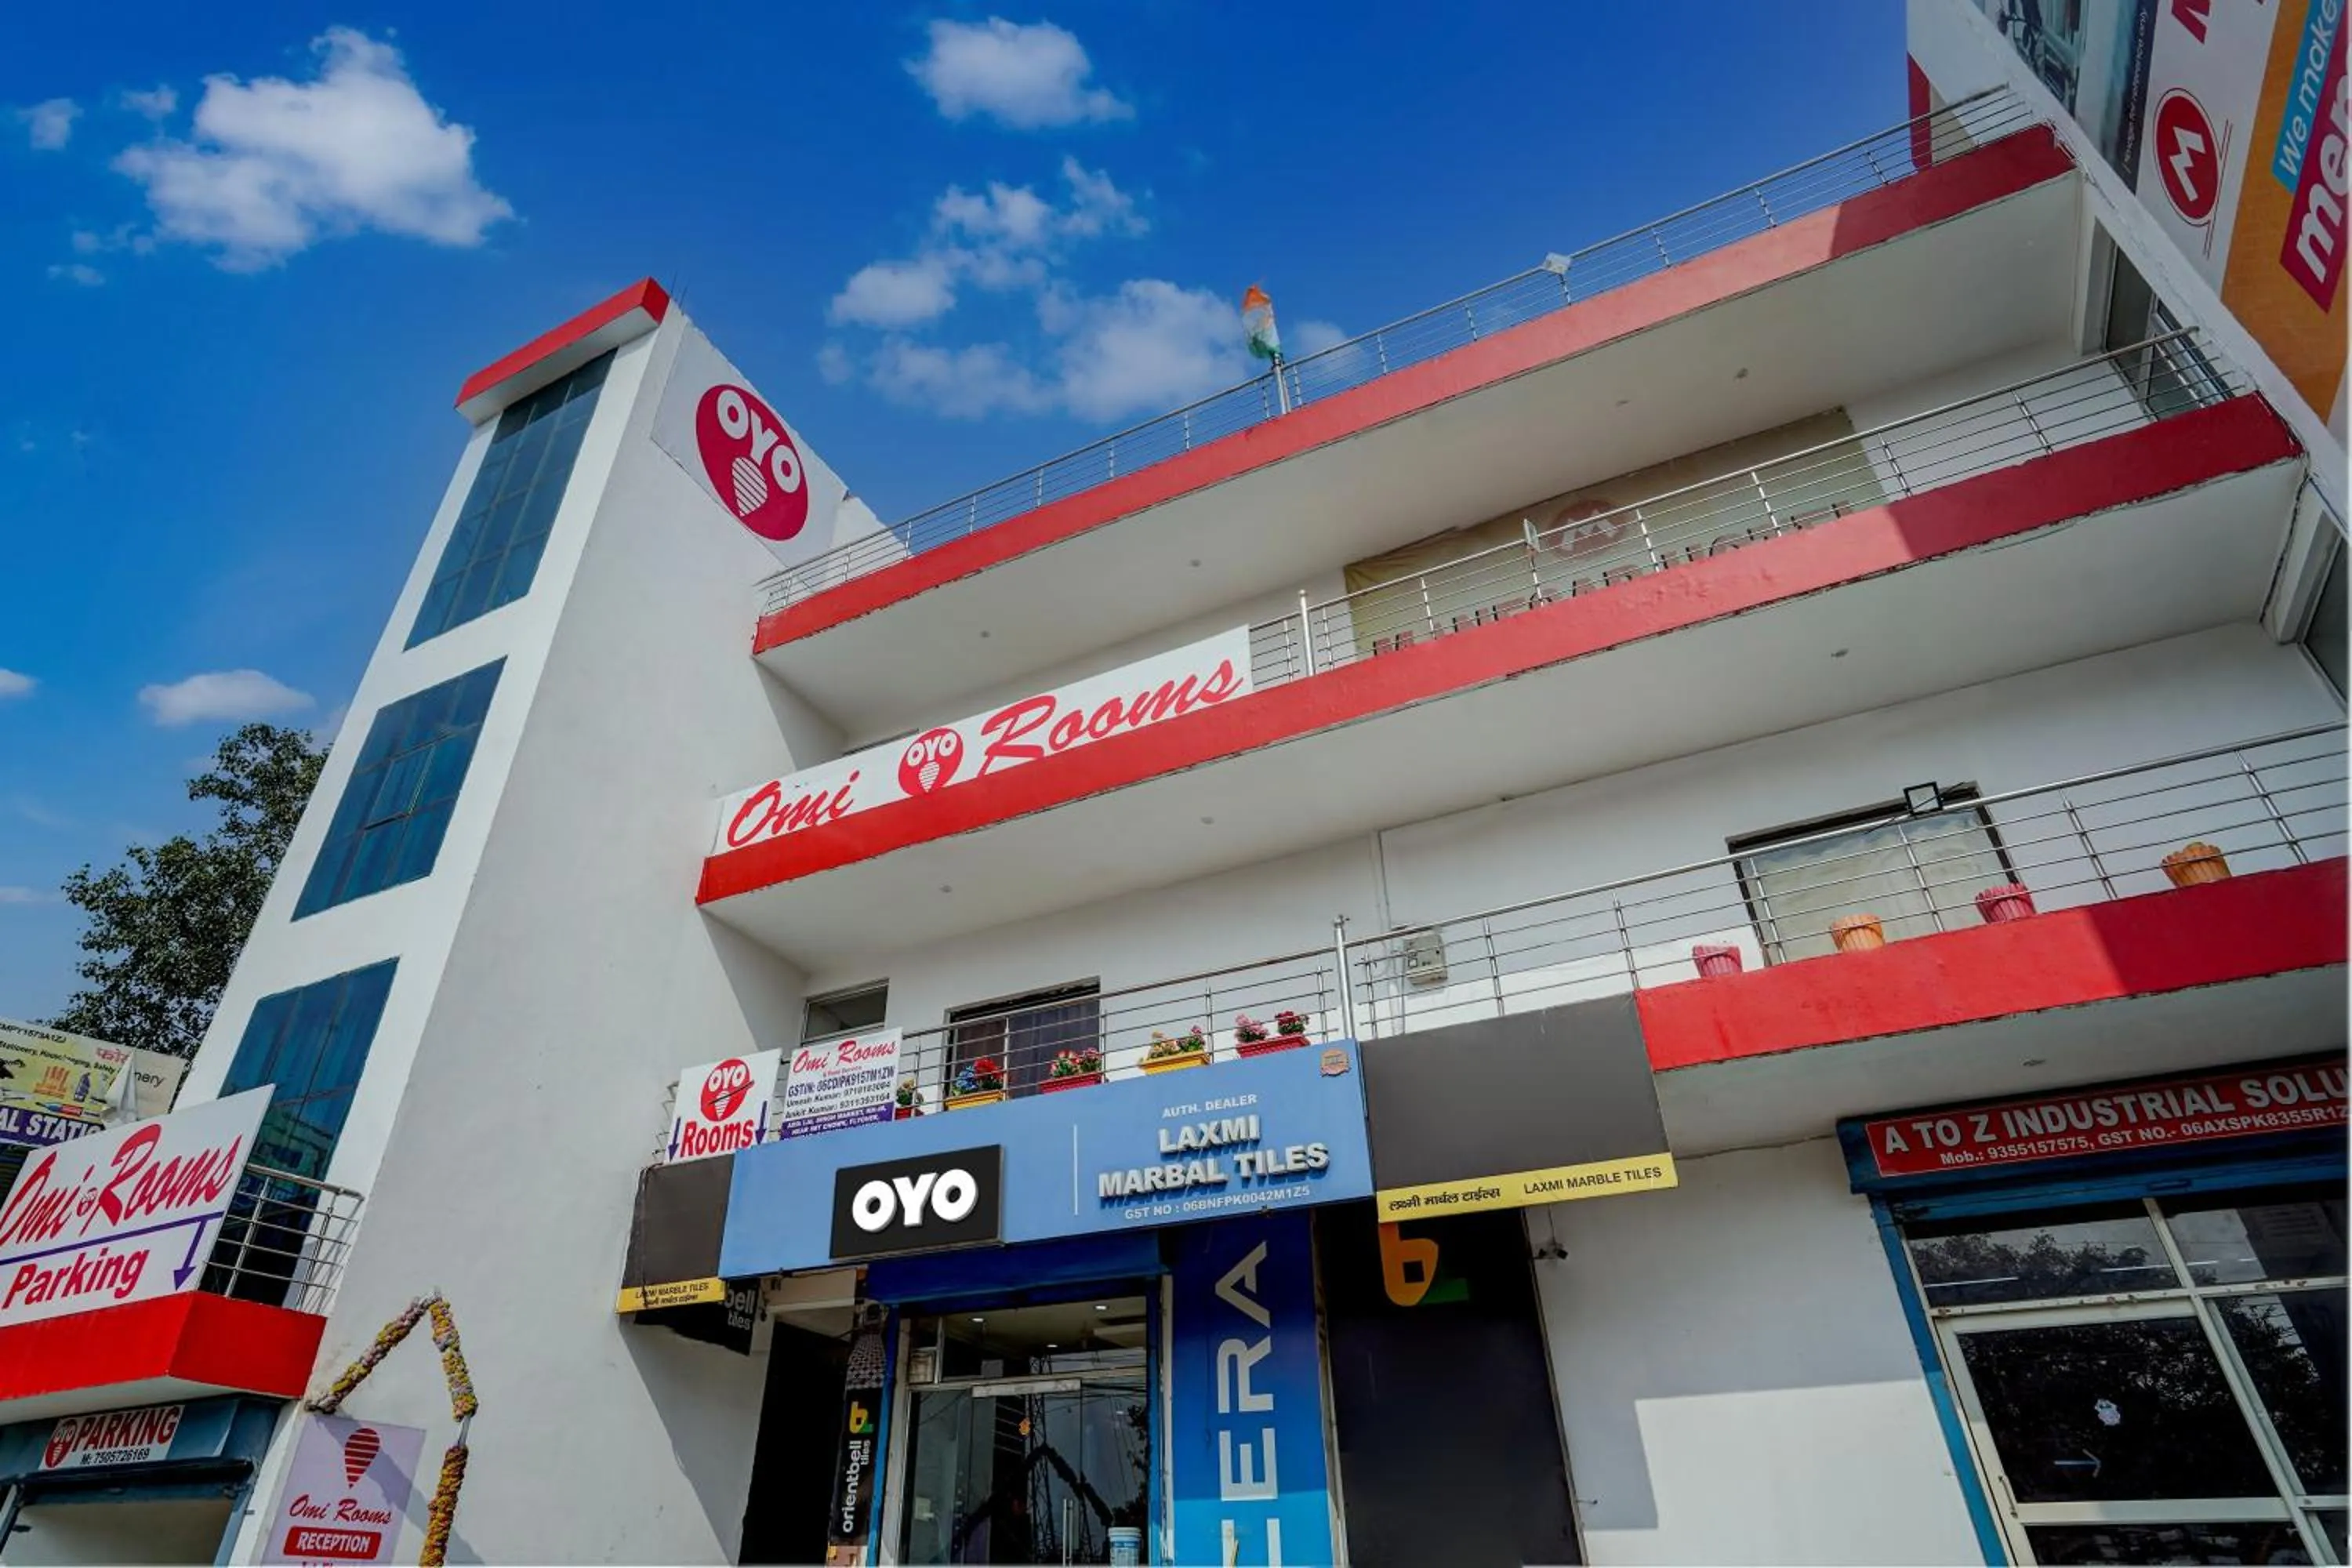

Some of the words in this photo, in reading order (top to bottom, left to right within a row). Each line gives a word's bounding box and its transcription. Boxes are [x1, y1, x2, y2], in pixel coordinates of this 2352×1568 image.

[2279, 116, 2307, 176] We
[2299, 0, 2337, 114] make
[717, 390, 800, 493] OYO
[726, 769, 860, 848] Omi
[907, 735, 960, 766] OYO
[975, 659, 1244, 779] Rooms
[793, 1050, 830, 1074] Omi
[836, 1038, 897, 1066] Rooms
[709, 1066, 745, 1091] OYO
[1162, 1102, 1201, 1119] AUTH.
[1205, 1094, 1257, 1112] DEALER
[1886, 1127, 1910, 1154] A
[1912, 1118, 1961, 1149] TO
[1969, 1114, 1998, 1142] Z
[2002, 1083, 2235, 1139] INDUSTRIAL
[681, 1120, 753, 1157] Rooms
[1158, 1114, 1261, 1154] LAXMI
[1987, 1136, 2095, 1160] 9355157575,
[2097, 1130, 2133, 1145] GST
[80, 1123, 242, 1236] Rooms
[1098, 1159, 1229, 1198] MARBAL
[1234, 1142, 1330, 1178] TILES
[1524, 1179, 1565, 1194] LAXMI
[1566, 1171, 1621, 1189] MARBLE
[1624, 1166, 1663, 1182] TILES
[852, 1168, 978, 1232] OYO
[1125, 1206, 1152, 1220] GST
[2, 1247, 150, 1310] Parking
[71, 1406, 180, 1453] PARKING
[860, 1439, 870, 1465] tiles
[842, 1439, 862, 1533] orientbell
[289, 1494, 330, 1519] Omi
[334, 1498, 392, 1525] Rooms
[296, 1531, 370, 1553] RECEPTION
